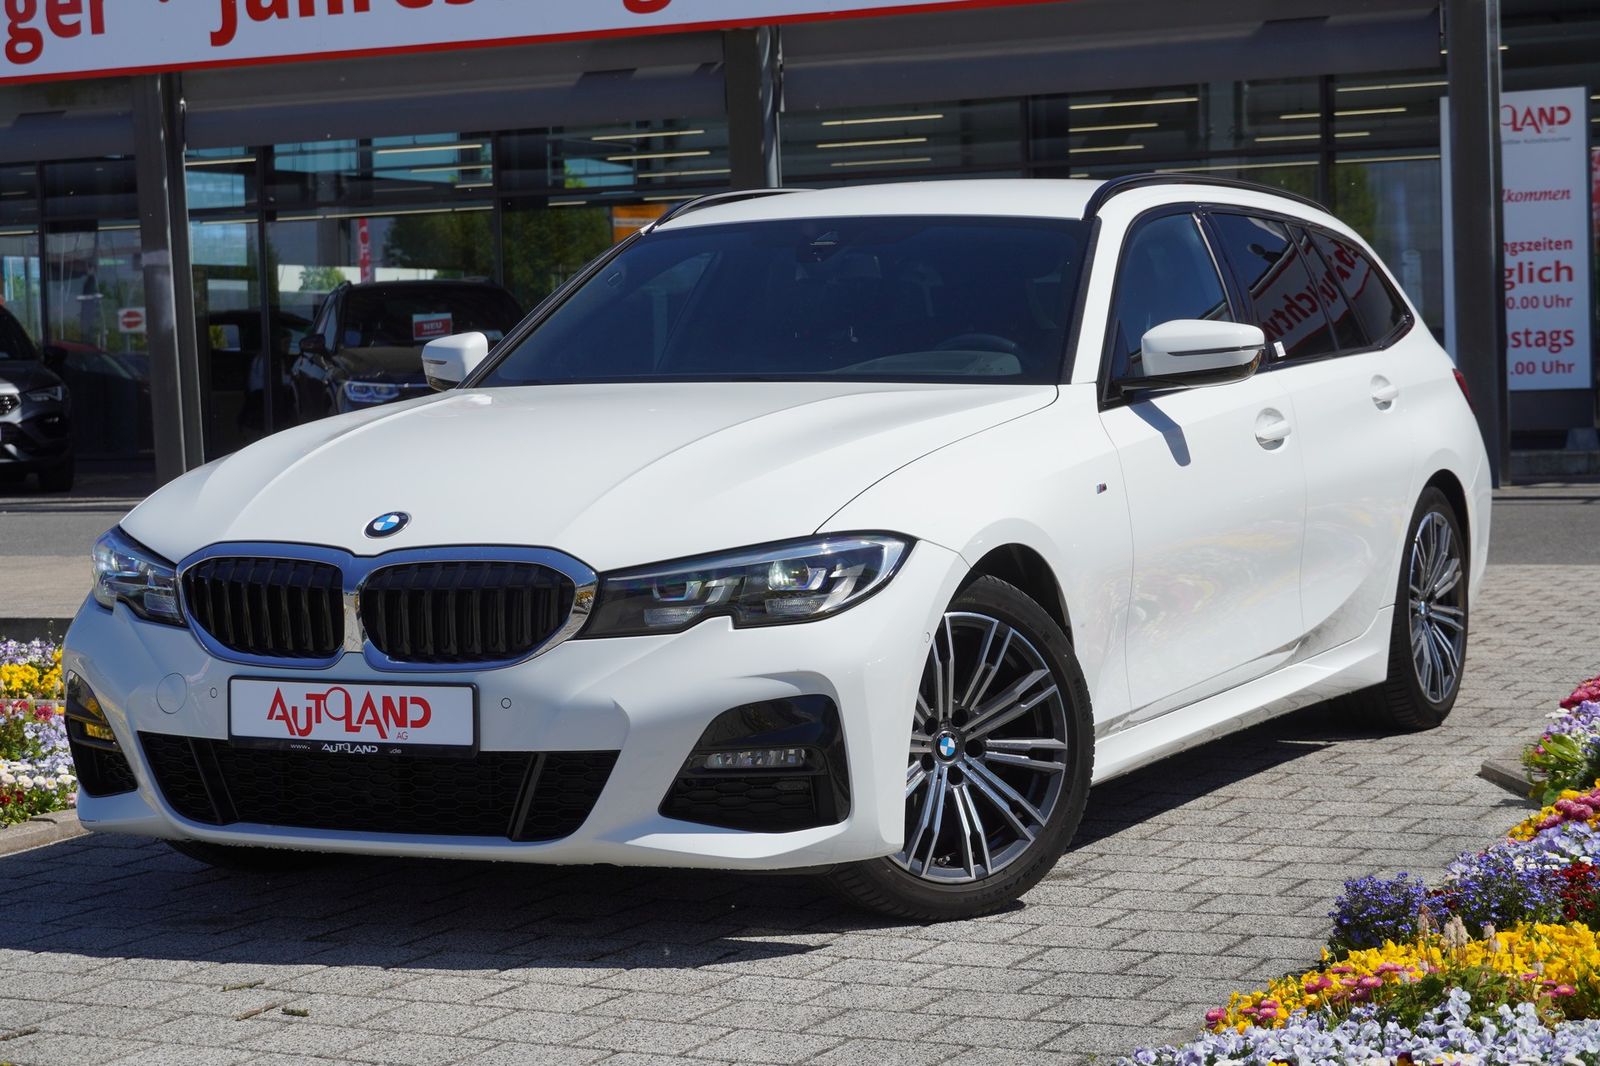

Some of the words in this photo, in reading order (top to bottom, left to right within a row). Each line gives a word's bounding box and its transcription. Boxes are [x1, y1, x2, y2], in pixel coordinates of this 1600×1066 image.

[1543, 294, 1574, 309] Uhr
[1541, 359, 1575, 375] Uhr
[266, 686, 432, 740] AUTOLAND
[395, 731, 409, 742] AG
[321, 742, 379, 754] AUTOLAND
